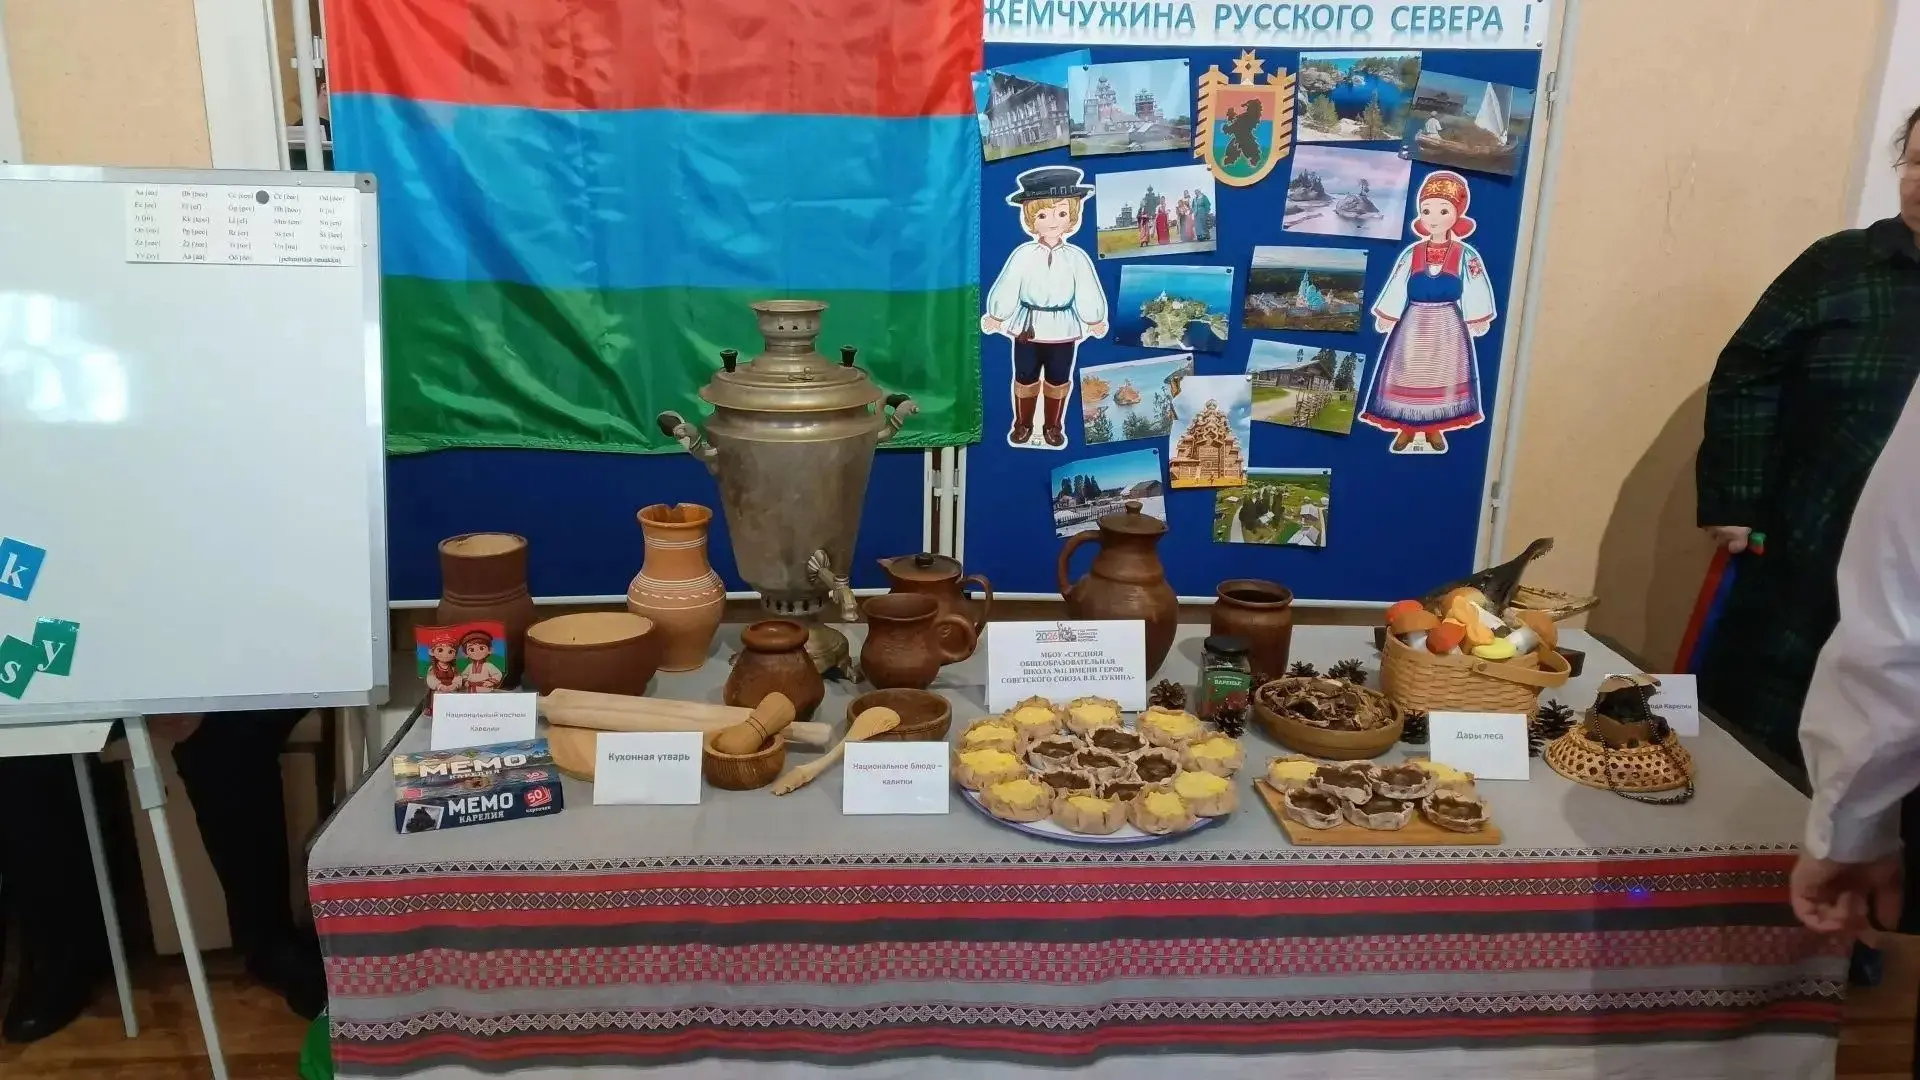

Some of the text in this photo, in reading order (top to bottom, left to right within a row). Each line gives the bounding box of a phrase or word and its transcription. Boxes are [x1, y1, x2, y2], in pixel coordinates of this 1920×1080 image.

[984, 0, 1531, 32] ЖЕМЧУЖИНА РУССКОГО СЕВЕРА !
[0, 552, 28, 589] k
[37, 640, 66, 671] y
[1019, 658, 1116, 667] ОБЩЕОБРАЗОВАТЕЛЬНАЯ
[0, 660, 21, 684] s
[1001, 676, 1052, 684] СОВЕТСКОГО
[1456, 731, 1504, 740] Дары леса
[608, 751, 691, 763] Кухонная утварь
[419, 754, 527, 778] МЕМО
[853, 762, 909, 771] Национальное
[882, 778, 913, 786] калитки
[527, 789, 543, 803] 50
[448, 792, 514, 816] МЕМО
[459, 811, 505, 823] КАРЕЛИЯ
